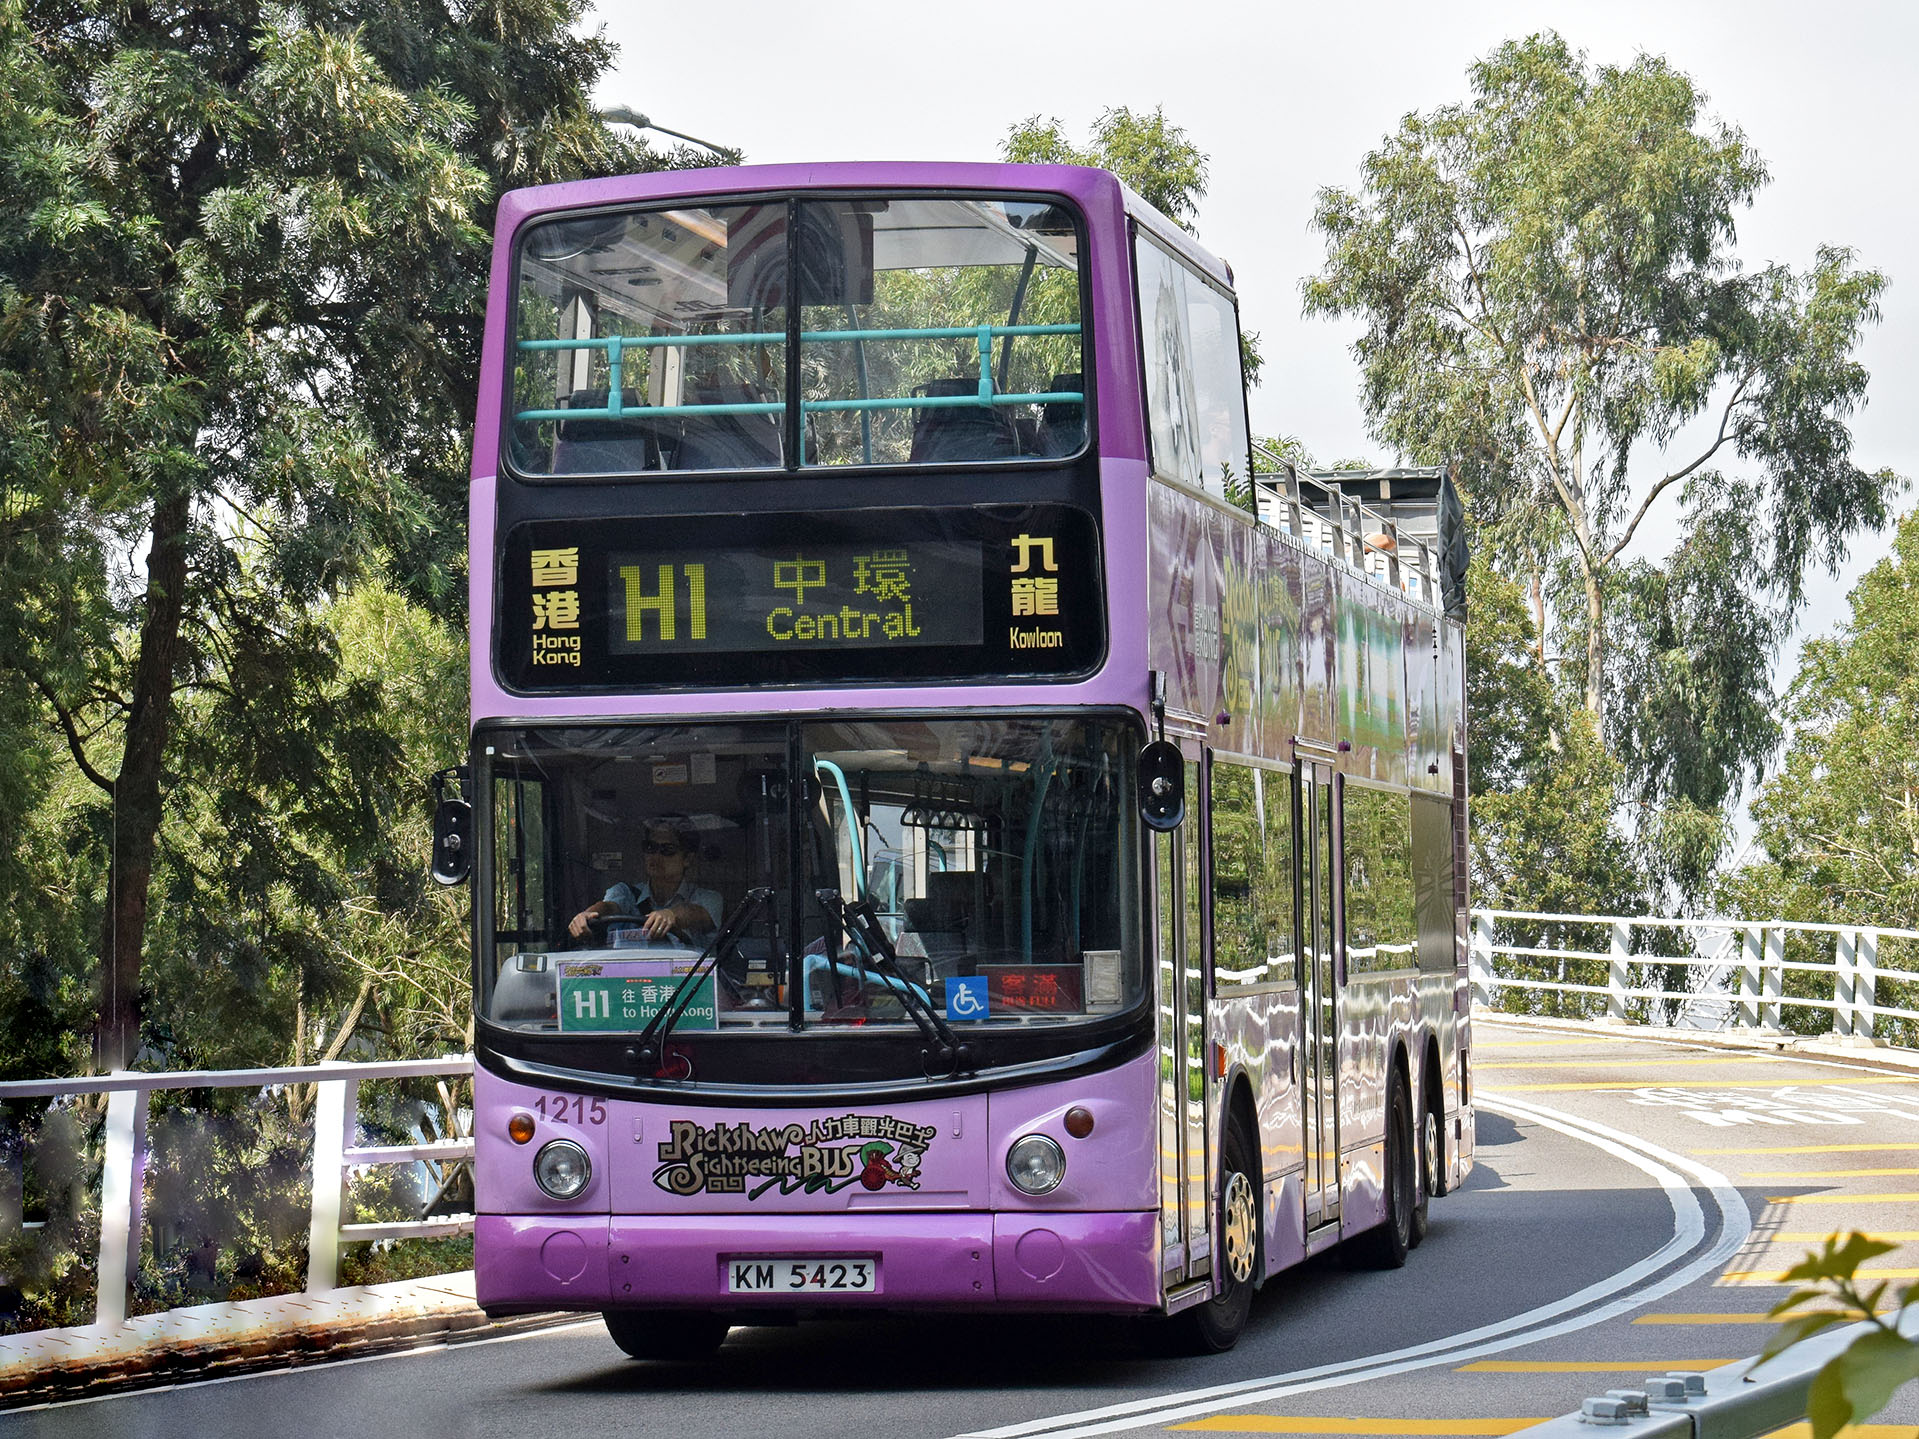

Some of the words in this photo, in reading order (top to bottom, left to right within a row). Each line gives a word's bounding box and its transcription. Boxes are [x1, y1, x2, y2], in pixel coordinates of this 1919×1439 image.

[531, 547, 581, 630] 香港
[1010, 533, 1060, 617] 九龍
[619, 562, 707, 642] H1
[766, 603, 921, 641] Central
[1009, 626, 1064, 650] Kowloon
[532, 634, 582, 653] Hong
[532, 650, 582, 668] Kong
[573, 990, 610, 1019] H1
[622, 1006, 637, 1018] to
[534, 1095, 608, 1125] 1215
[659, 1120, 804, 1161] Rickshaw
[804, 1114, 937, 1148] 人力車觀光巴士
[668, 1152, 802, 1195] Sightseeing
[800, 1145, 866, 1177] BUS
[734, 1264, 775, 1290] KM
[788, 1263, 869, 1290] 5423
